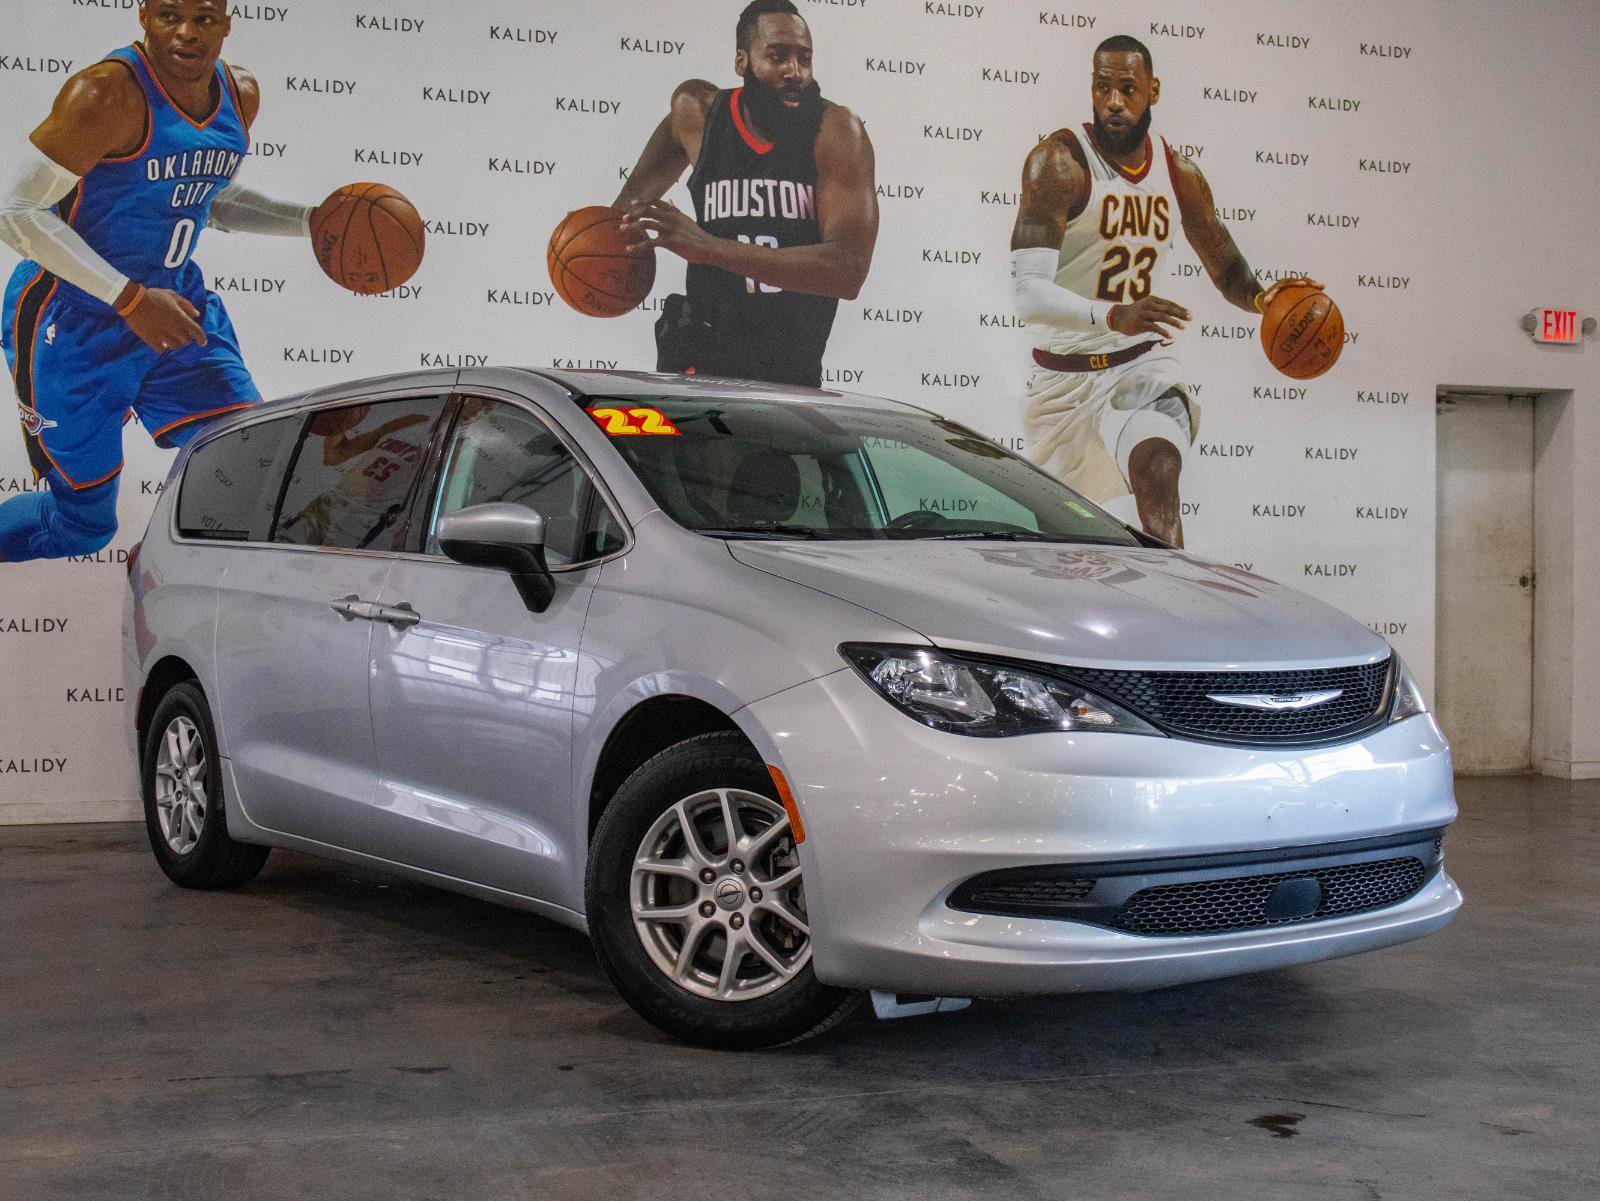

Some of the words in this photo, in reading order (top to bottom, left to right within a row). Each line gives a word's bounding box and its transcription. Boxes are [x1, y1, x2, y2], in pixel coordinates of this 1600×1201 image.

[231, 5, 288, 22] ALIDY
[926, 1, 984, 18] KALIDY
[356, 15, 424, 33] KALIDY
[1040, 12, 1096, 28] KALIDY
[490, 26, 557, 44] KALIDY
[1151, 23, 1204, 38] KALIDY
[621, 37, 684, 55] KALIDY
[1257, 34, 1310, 48] KALIDY
[1360, 43, 1411, 58] KALIDY
[0, 56, 73, 73] KALIDY
[867, 58, 925, 75] KALIDY
[983, 68, 1039, 84] KALIDY
[287, 77, 356, 94] KALIDY
[424, 87, 490, 104] KALIDY
[1204, 88, 1257, 103] KALIDY
[556, 97, 620, 114] KALIDY
[1309, 97, 1360, 112] KALIDY
[924, 125, 982, 141] KALIDY
[146, 149, 239, 181] OKLAHOM
[355, 149, 423, 166] KALIDY
[1256, 151, 1309, 166] KALIDY
[489, 158, 555, 175] KALIDY
[1360, 159, 1410, 174] KALIDY
[171, 181, 214, 208] CITY
[875, 184, 925, 200] ALIDY
[981, 192, 1022, 206] KALI
[704, 178, 814, 222] HOUSTON
[1100, 194, 1169, 242] CAVS
[1214, 207, 1256, 221] ALIDY
[1308, 214, 1359, 228] KALIDY
[422, 220, 489, 237] KALIDY
[164, 218, 195, 269] 0
[923, 249, 981, 264] KALIDY
[1096, 245, 1157, 303] 23
[214, 276, 285, 293] KALIDY
[1359, 275, 1409, 289] KALIDY
[488, 290, 554, 305] KALIDY
[864, 308, 923, 323] KALIDY
[1202, 325, 1255, 339] KALIDY
[1543, 309, 1578, 342] EXIT
[284, 348, 354, 363] KALIDY
[420, 353, 487, 367] KALIDY
[1089, 354, 1109, 369] CLE
[821, 369, 864, 384] LIDY
[922, 373, 980, 387] KALIDY
[1254, 387, 1306, 399] KALIDY
[1357, 391, 1408, 404] KALIDY
[592, 407, 675, 436] 22
[1200, 444, 1254, 457] KALIDY
[1306, 448, 1357, 460] KALIDY
[919, 498, 978, 513] KALIDY
[1253, 505, 1305, 517] KALIDY
[1357, 507, 1407, 519] KALIDY
[1305, 564, 1356, 577] KALIDY
